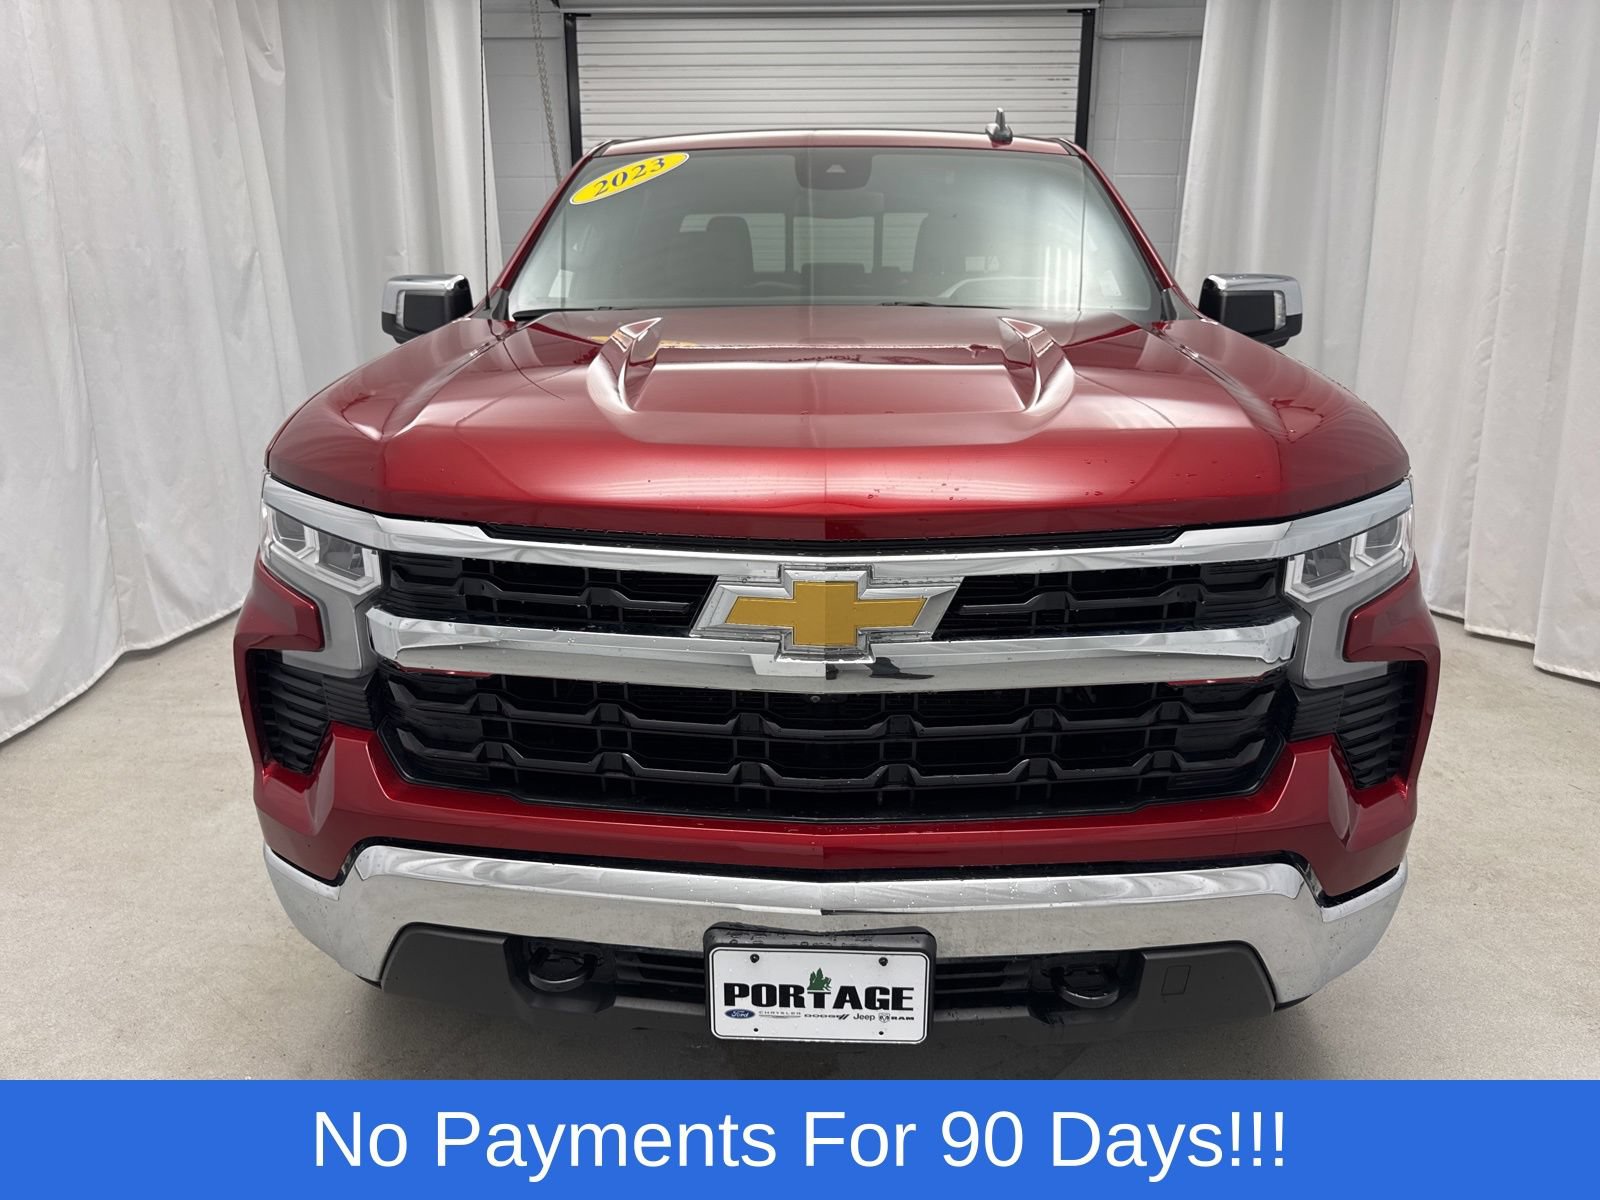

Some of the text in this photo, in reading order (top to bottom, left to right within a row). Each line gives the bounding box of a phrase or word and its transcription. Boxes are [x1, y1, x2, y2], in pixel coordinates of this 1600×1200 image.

[593, 157, 665, 197] 2023
[724, 982, 914, 1011] PORTAGE
[853, 1013, 876, 1021] Jeep
